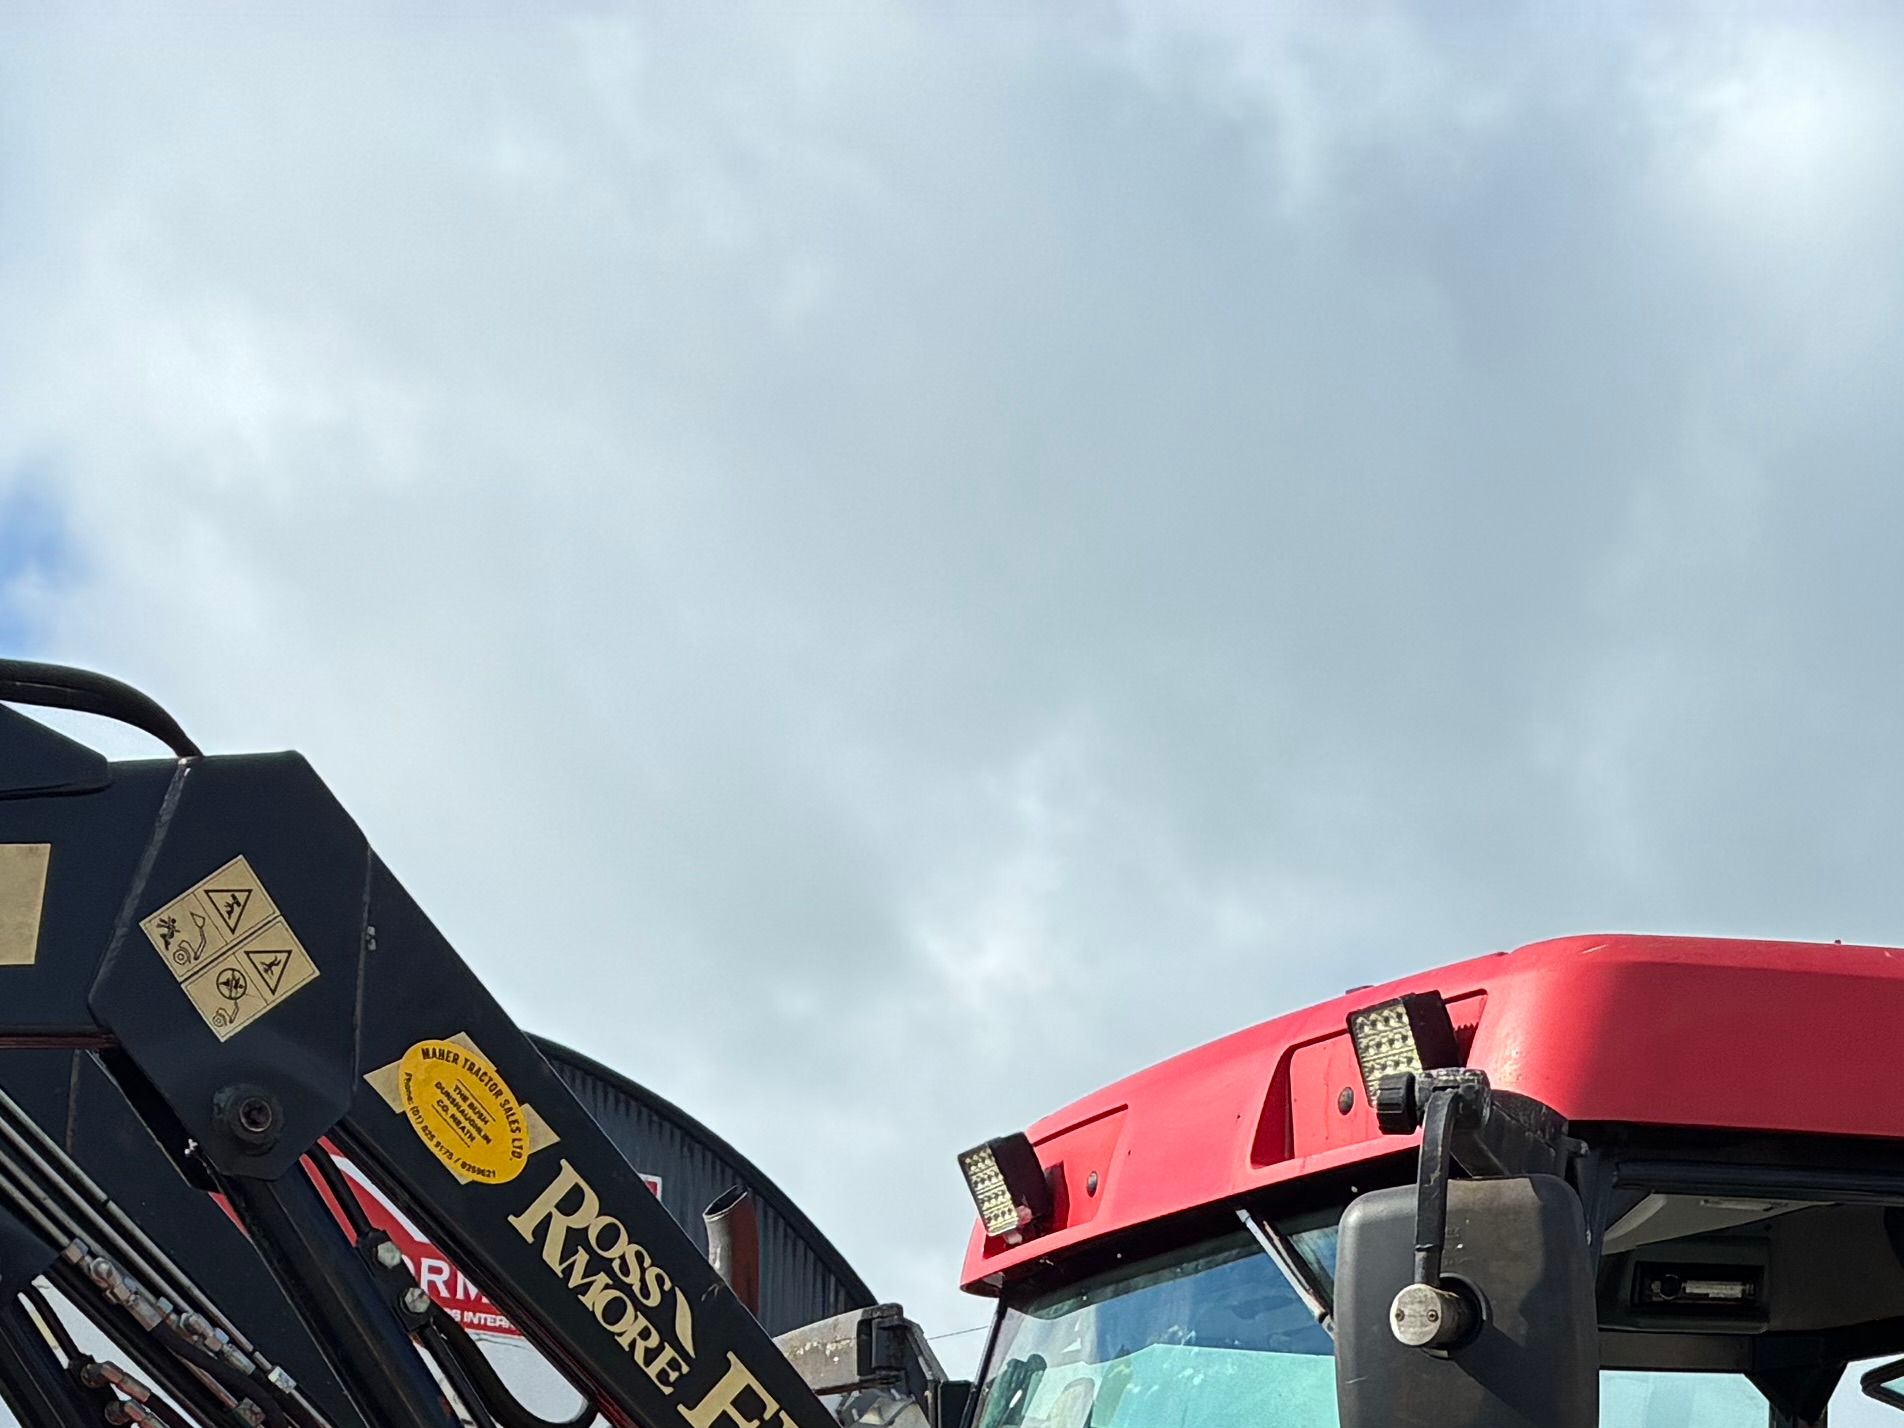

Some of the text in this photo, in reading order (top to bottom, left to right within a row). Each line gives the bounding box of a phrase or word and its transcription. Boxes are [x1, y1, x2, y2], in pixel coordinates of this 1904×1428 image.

[421, 1047, 460, 1065] MAHER
[462, 1057, 503, 1098] TRACTOR
[499, 1097, 522, 1134] SALES
